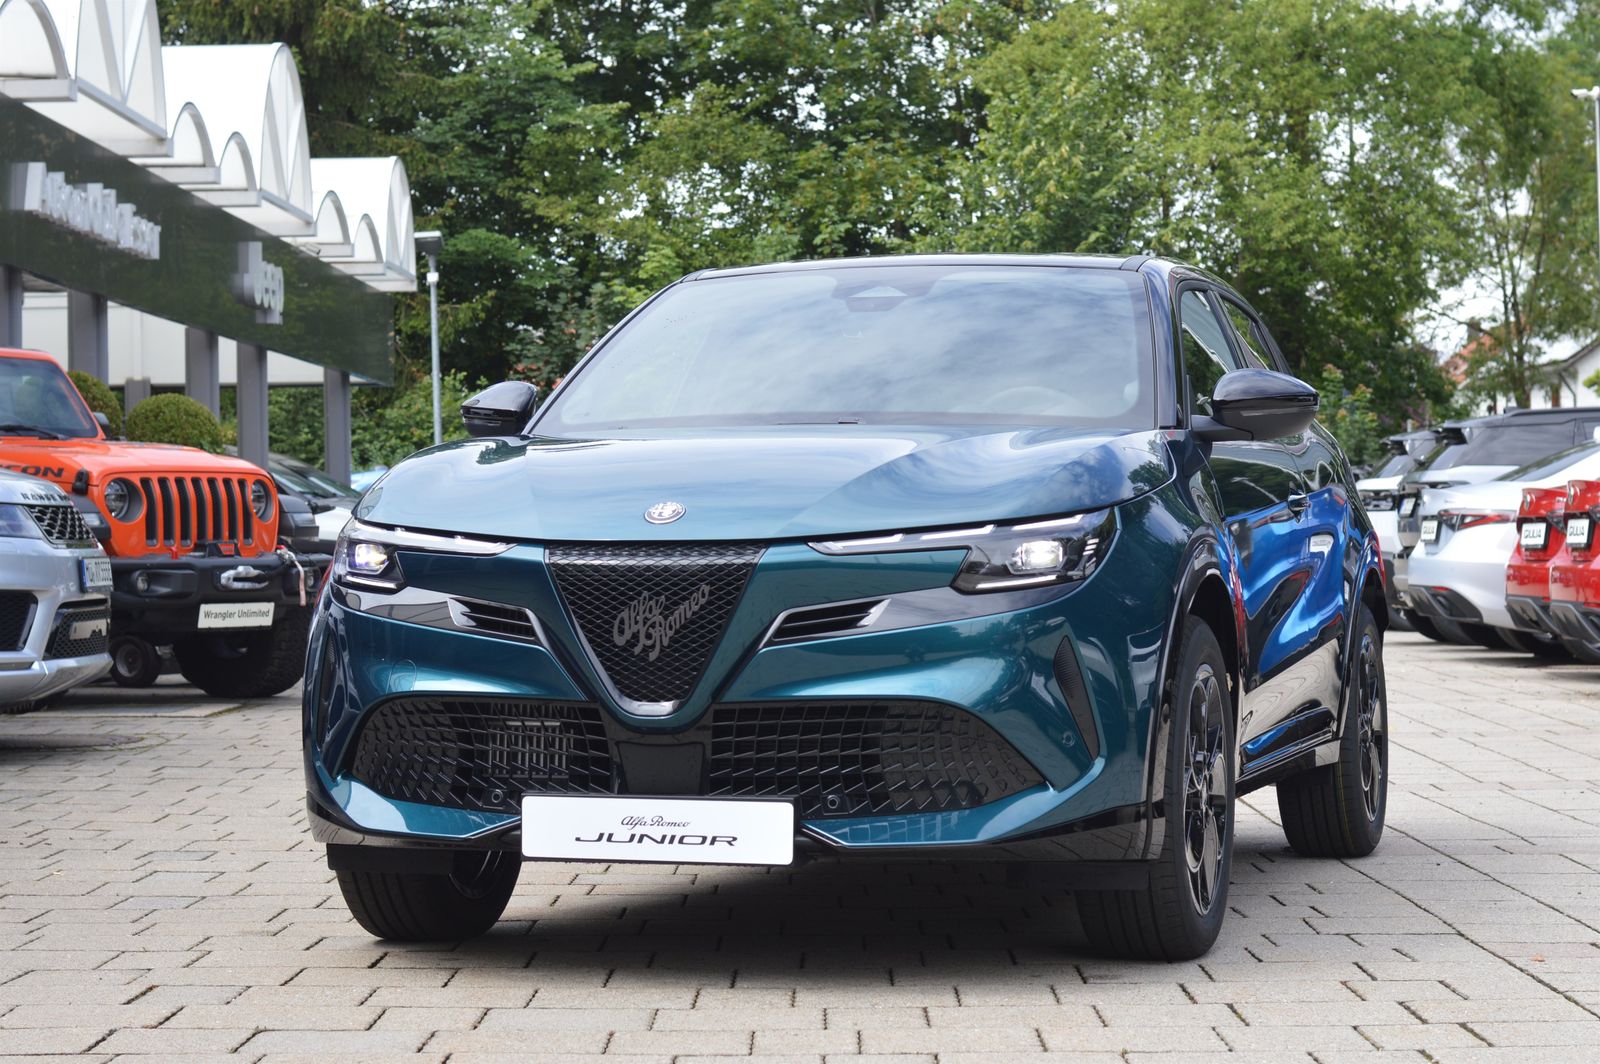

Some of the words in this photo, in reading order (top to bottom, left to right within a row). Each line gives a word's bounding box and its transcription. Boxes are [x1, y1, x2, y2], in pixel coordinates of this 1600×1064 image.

[203, 609, 236, 621] Wrangler
[237, 608, 270, 618] Unlimited
[613, 590, 665, 656] Alfa
[643, 584, 710, 662] Romeo
[621, 815, 648, 831] Alfa
[649, 815, 691, 828] Romeo
[575, 832, 738, 847] JUNIOR
